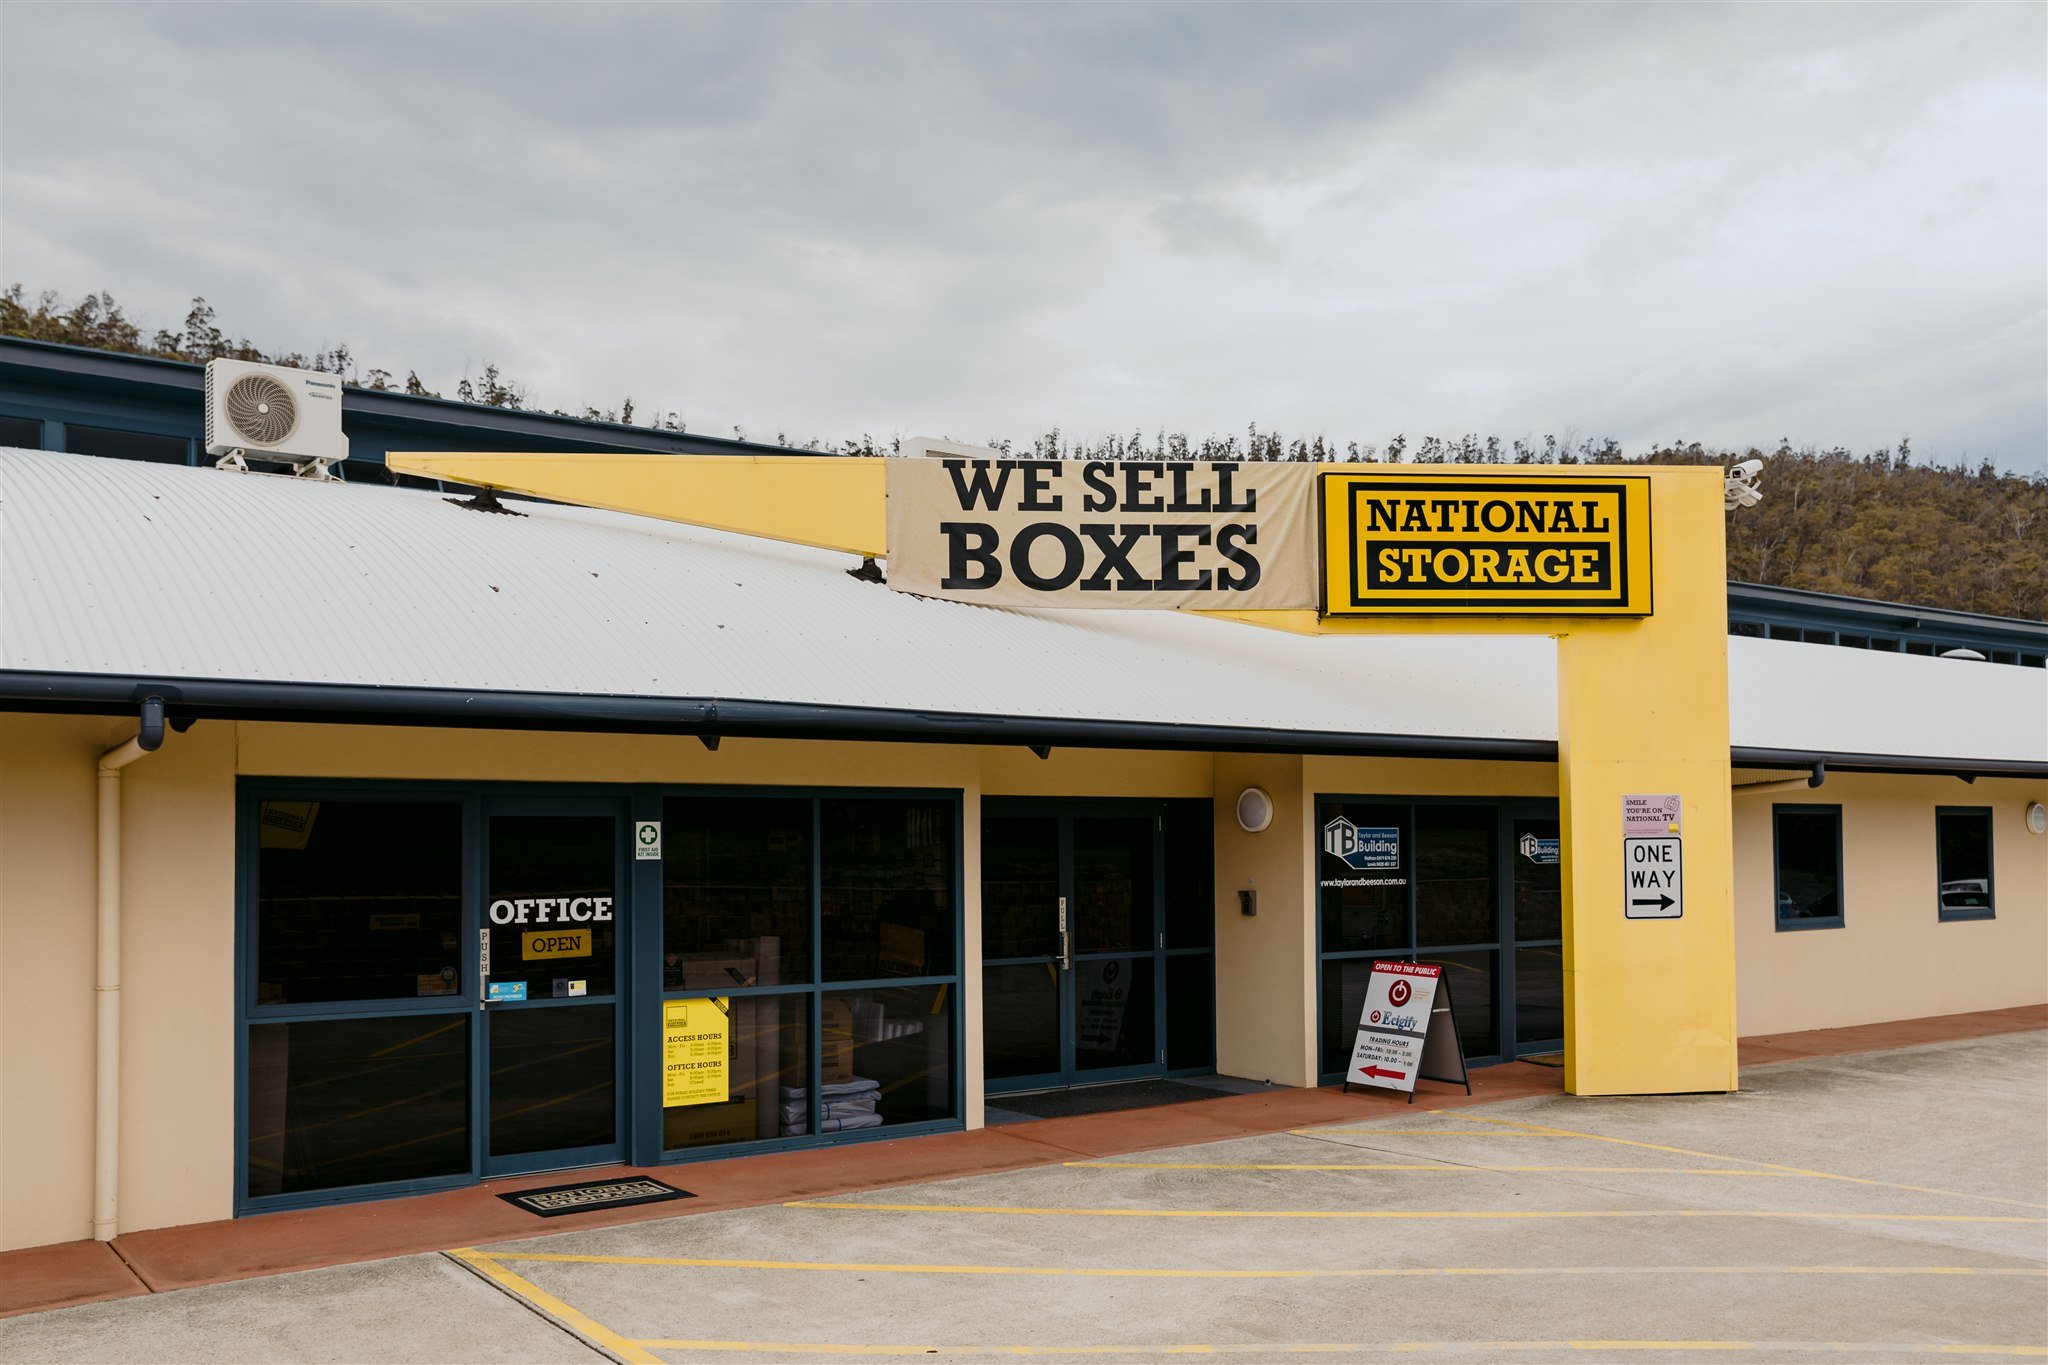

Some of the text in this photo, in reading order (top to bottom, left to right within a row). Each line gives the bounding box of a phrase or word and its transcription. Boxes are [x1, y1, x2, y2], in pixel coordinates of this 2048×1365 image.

[305, 379, 336, 389] Panasonic
[942, 460, 1256, 513] WE SELL
[1366, 499, 1609, 533] NATIONAL
[940, 522, 1261, 591] BOXES
[1378, 548, 1599, 583] STORAGE
[1662, 813, 1675, 822] TV
[1327, 822, 1355, 854] TB
[1358, 840, 1397, 855] Building
[1537, 847, 1558, 855] Building
[1633, 845, 1673, 863] ONE
[1631, 870, 1675, 888] WAY
[489, 897, 613, 925] OFFICE
[532, 935, 582, 953] OPEN
[1375, 963, 1437, 976] OPEN TO THE PUBLIC
[1381, 1010, 1418, 1031] Ecigify
[667, 1035, 696, 1043] ACCESS
[1369, 1036, 1410, 1047] TRADING HOURS
[667, 1063, 696, 1071] OFFICE
[528, 1182, 652, 1204] NATIONAL
